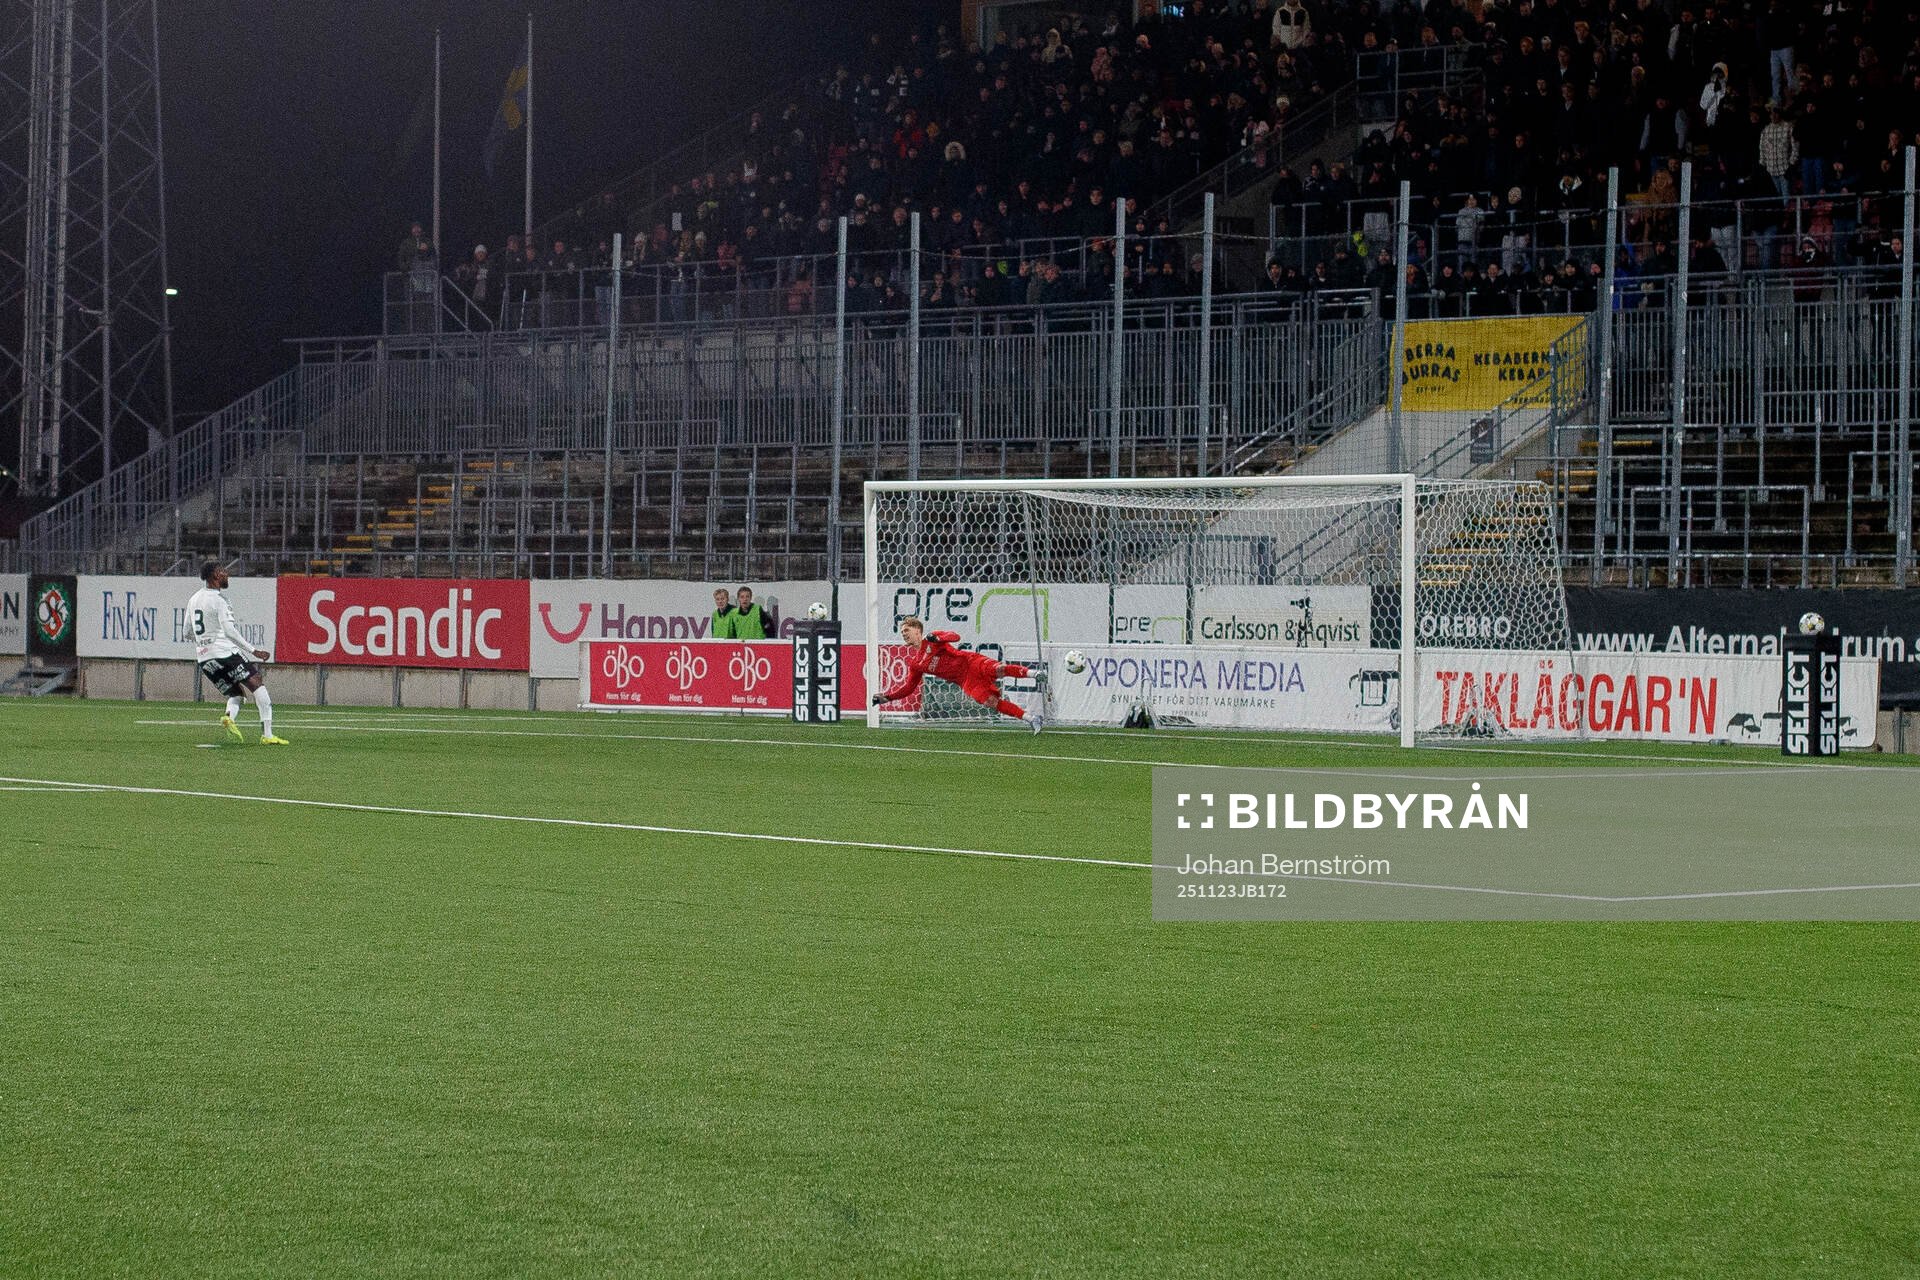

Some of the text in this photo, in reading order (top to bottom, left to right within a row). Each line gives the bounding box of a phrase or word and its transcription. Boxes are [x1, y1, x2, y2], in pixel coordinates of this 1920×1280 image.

[0, 592, 20, 620] N
[195, 609, 205, 635] 3
[307, 588, 502, 660] Scandic
[1115, 616, 1151, 636] pre
[1201, 615, 1279, 640] Carlsson
[603, 645, 645, 688] ÖBO
[665, 645, 707, 690] ÖBO
[728, 646, 771, 691] ÖBO
[796, 635, 809, 721] SELECT
[817, 635, 837, 721] SELECT
[1218, 660, 1305, 692] MEDIA
[1436, 659, 1717, 735] TAKLÄGGAR'N
[1787, 651, 1810, 754] SELECT
[1820, 651, 1837, 754] SELECT
